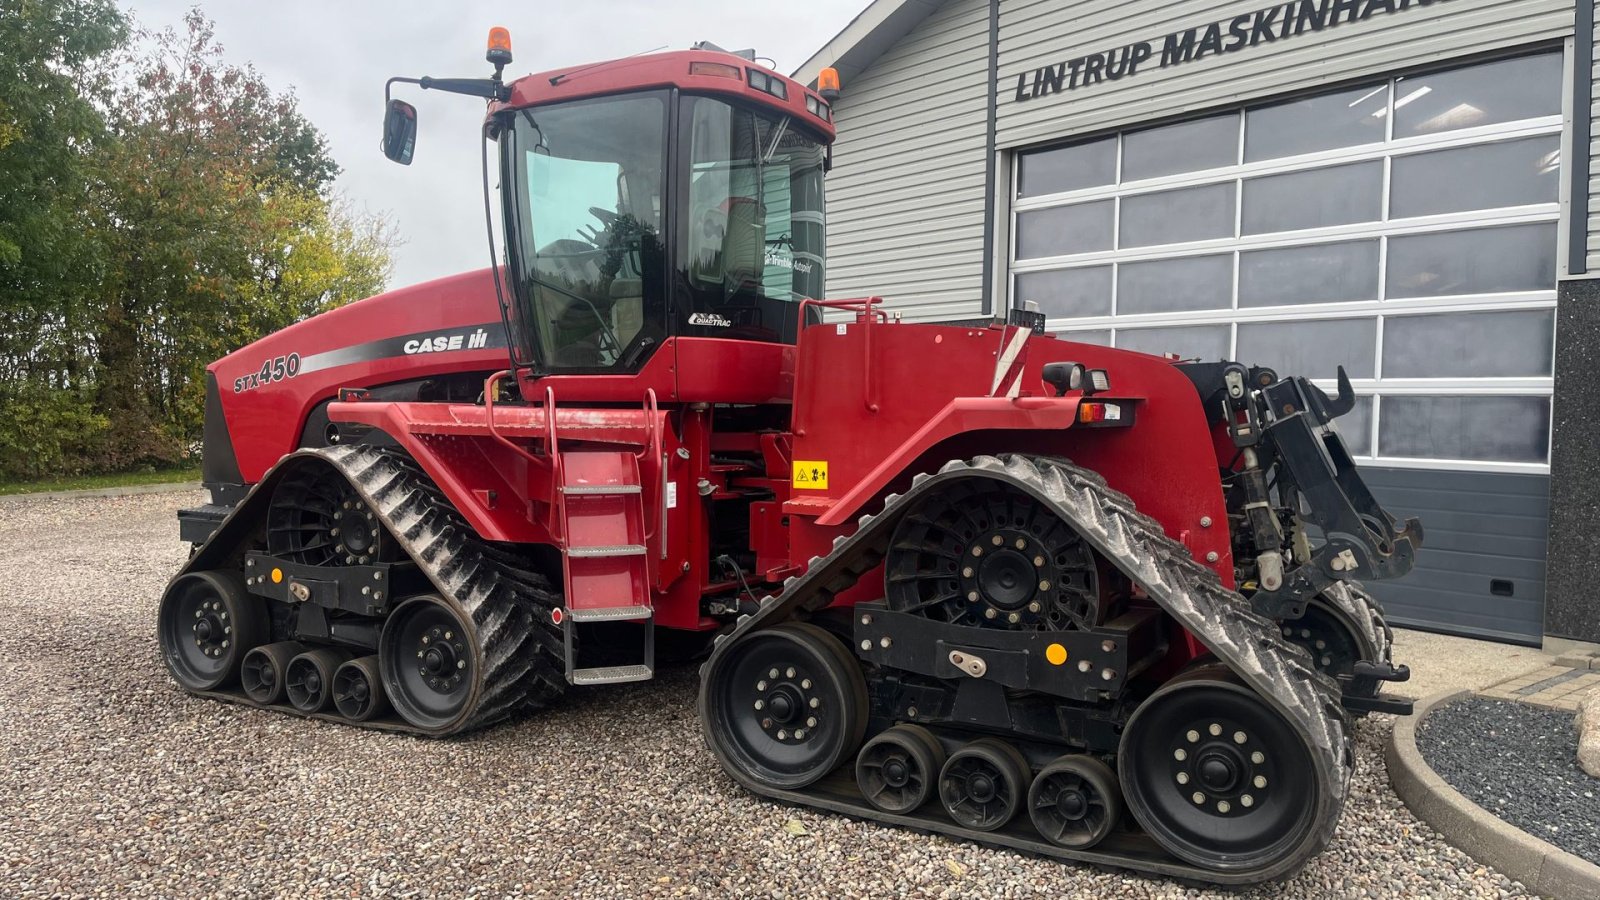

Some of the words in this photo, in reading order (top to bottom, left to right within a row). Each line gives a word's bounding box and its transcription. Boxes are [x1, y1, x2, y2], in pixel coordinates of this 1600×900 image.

[1015, 41, 1152, 101] LINTRUP
[771, 254, 793, 269] Trimble
[404, 335, 464, 355] CASE
